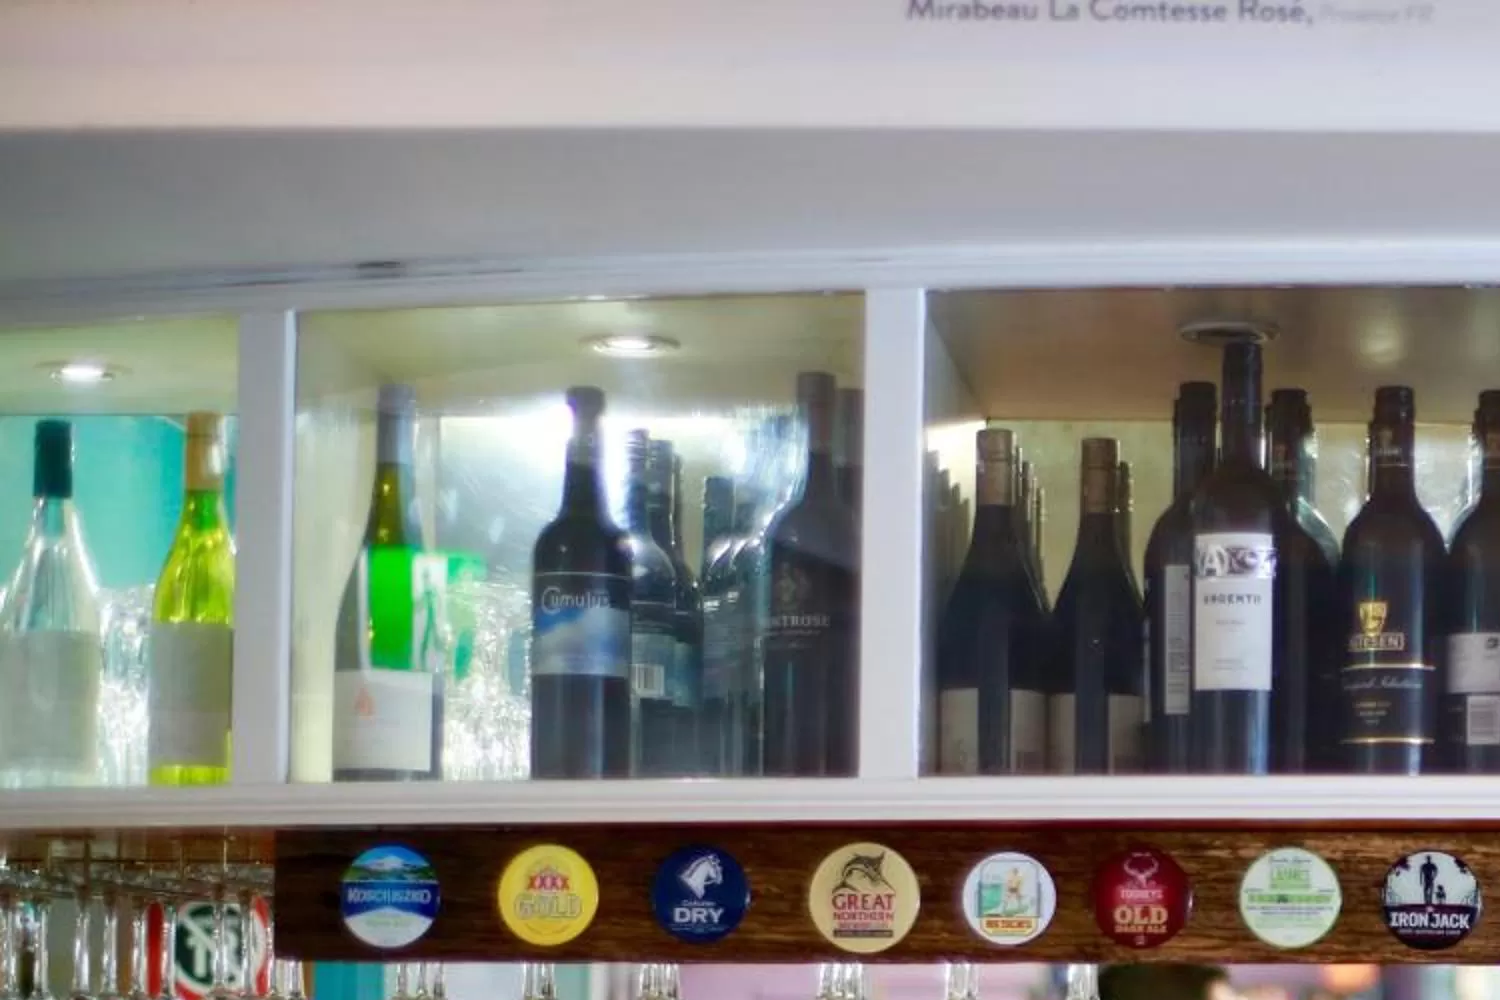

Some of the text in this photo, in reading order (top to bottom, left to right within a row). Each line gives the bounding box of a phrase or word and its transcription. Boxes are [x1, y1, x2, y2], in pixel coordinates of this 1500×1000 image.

[905, 0, 1038, 20] Mirabeau
[1049, 0, 1081, 20] La
[1090, 0, 1227, 21] Comtesse
[526, 873, 570, 891] XXXX
[513, 892, 584, 920] GOLD
[831, 893, 896, 911] GREAT
[673, 907, 725, 925] DRY
[832, 911, 895, 921] NORTHERN
[1113, 904, 1168, 925] OLD
[1390, 911, 1471, 930] IRON JACK
